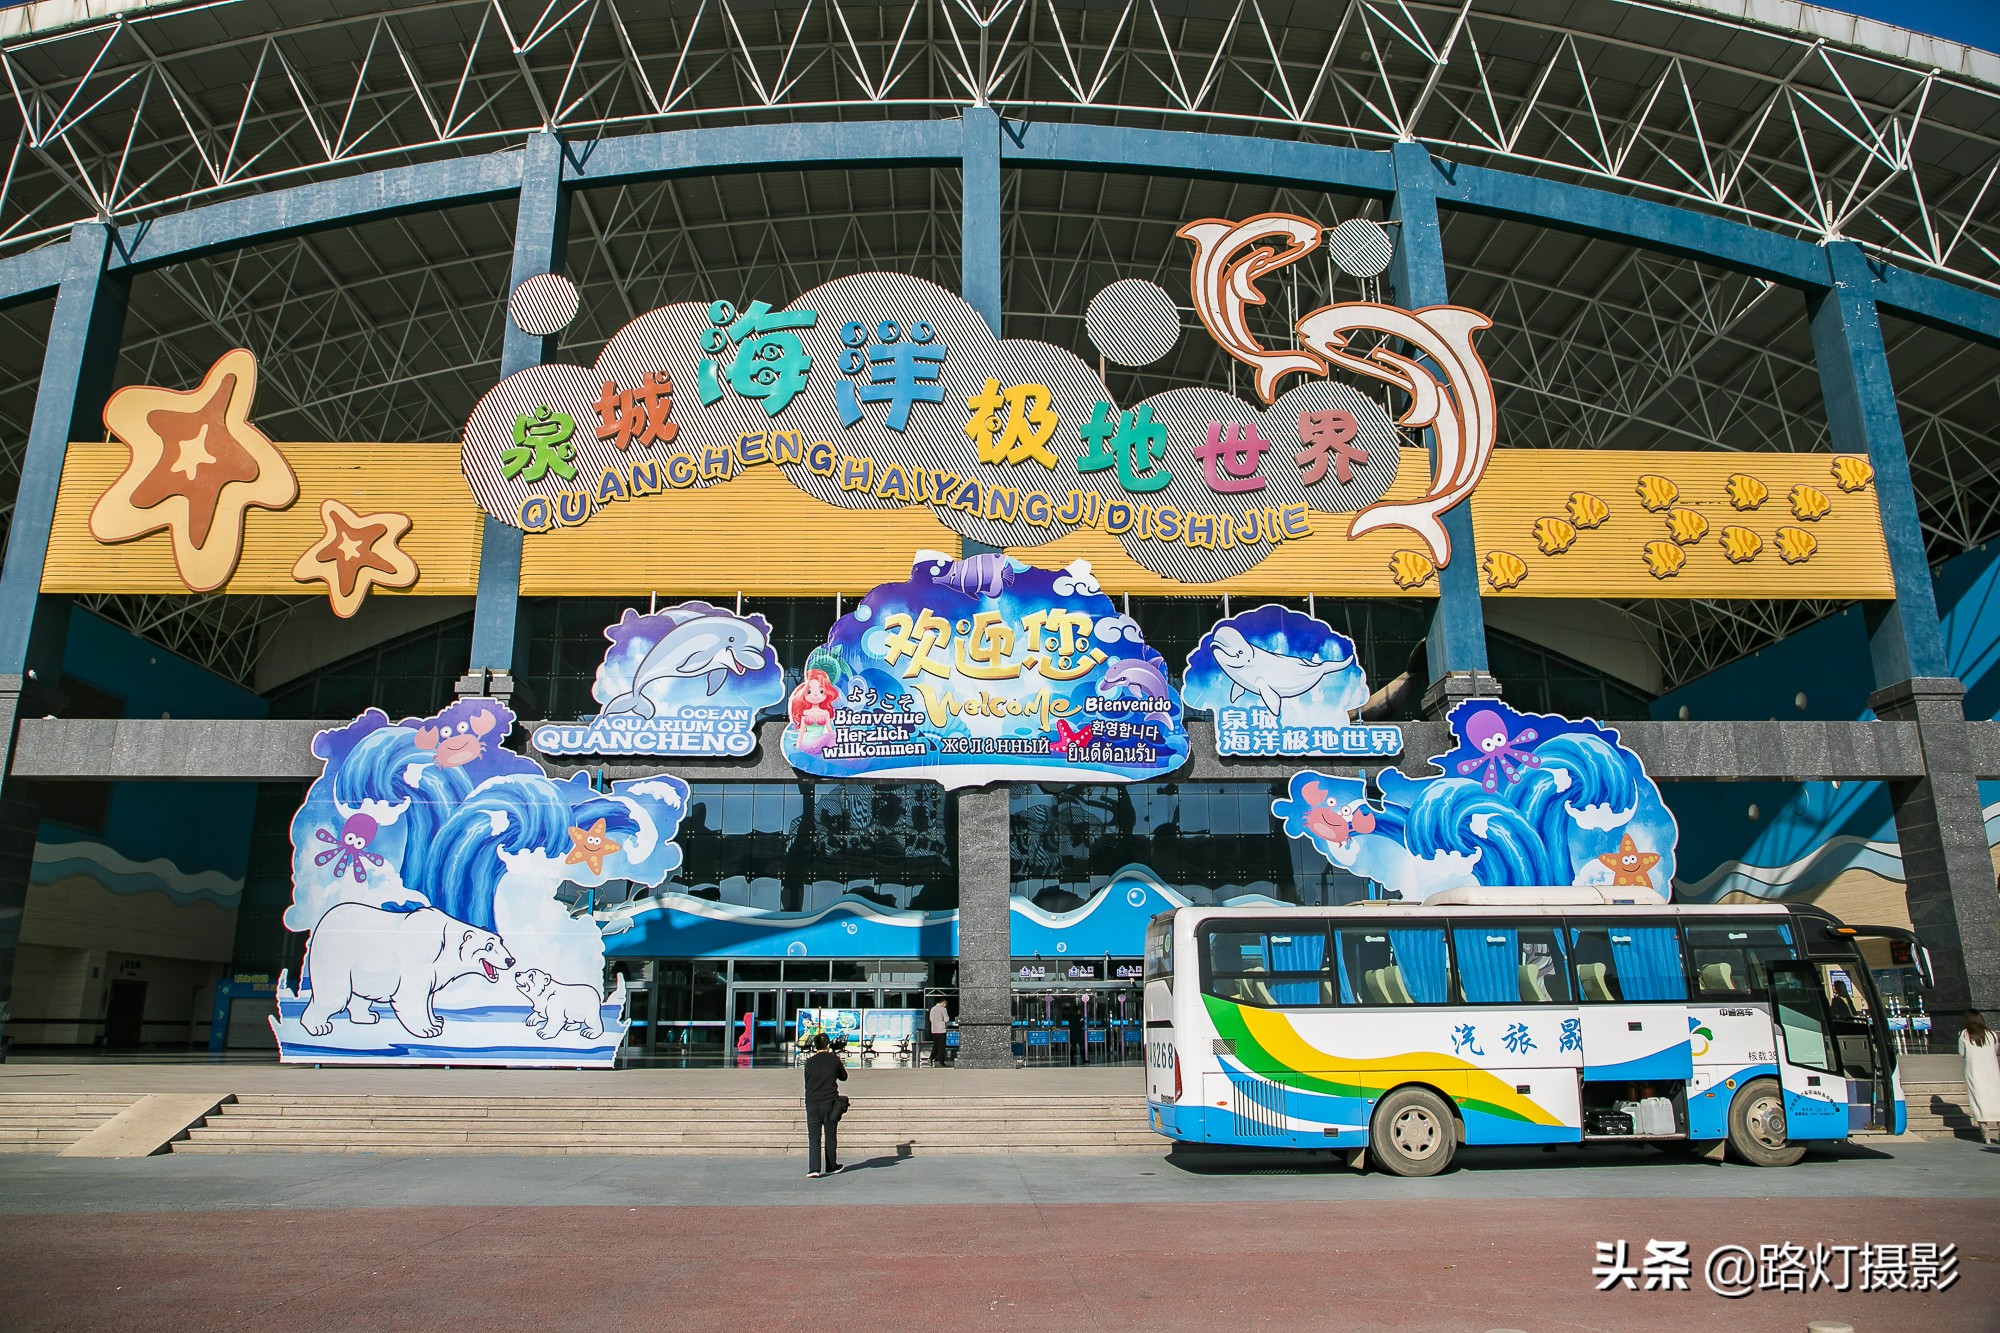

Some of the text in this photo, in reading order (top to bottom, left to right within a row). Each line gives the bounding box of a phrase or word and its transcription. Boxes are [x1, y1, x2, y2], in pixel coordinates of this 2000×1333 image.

[500, 300, 1369, 494] 泉城海洋极地世界
[884, 608, 1108, 681] 欢迎您
[848, 686, 914, 712] ようこそ
[1085, 697, 1171, 712] Bienvenido
[680, 708, 748, 720] OCEAN
[834, 709, 925, 725] Bienvenue
[1221, 708, 1280, 729] 泉城
[594, 719, 748, 733] AQUARIUM OF
[836, 726, 909, 742] Herzlich
[1092, 720, 1159, 740] 환영합니다
[537, 731, 750, 751] QUANCHENG
[822, 742, 927, 758] willkommen
[941, 737, 1050, 754] желанный
[1223, 730, 1399, 751] 海洋极地世界
[1068, 743, 1156, 762] ยินดีต้อนรับ
